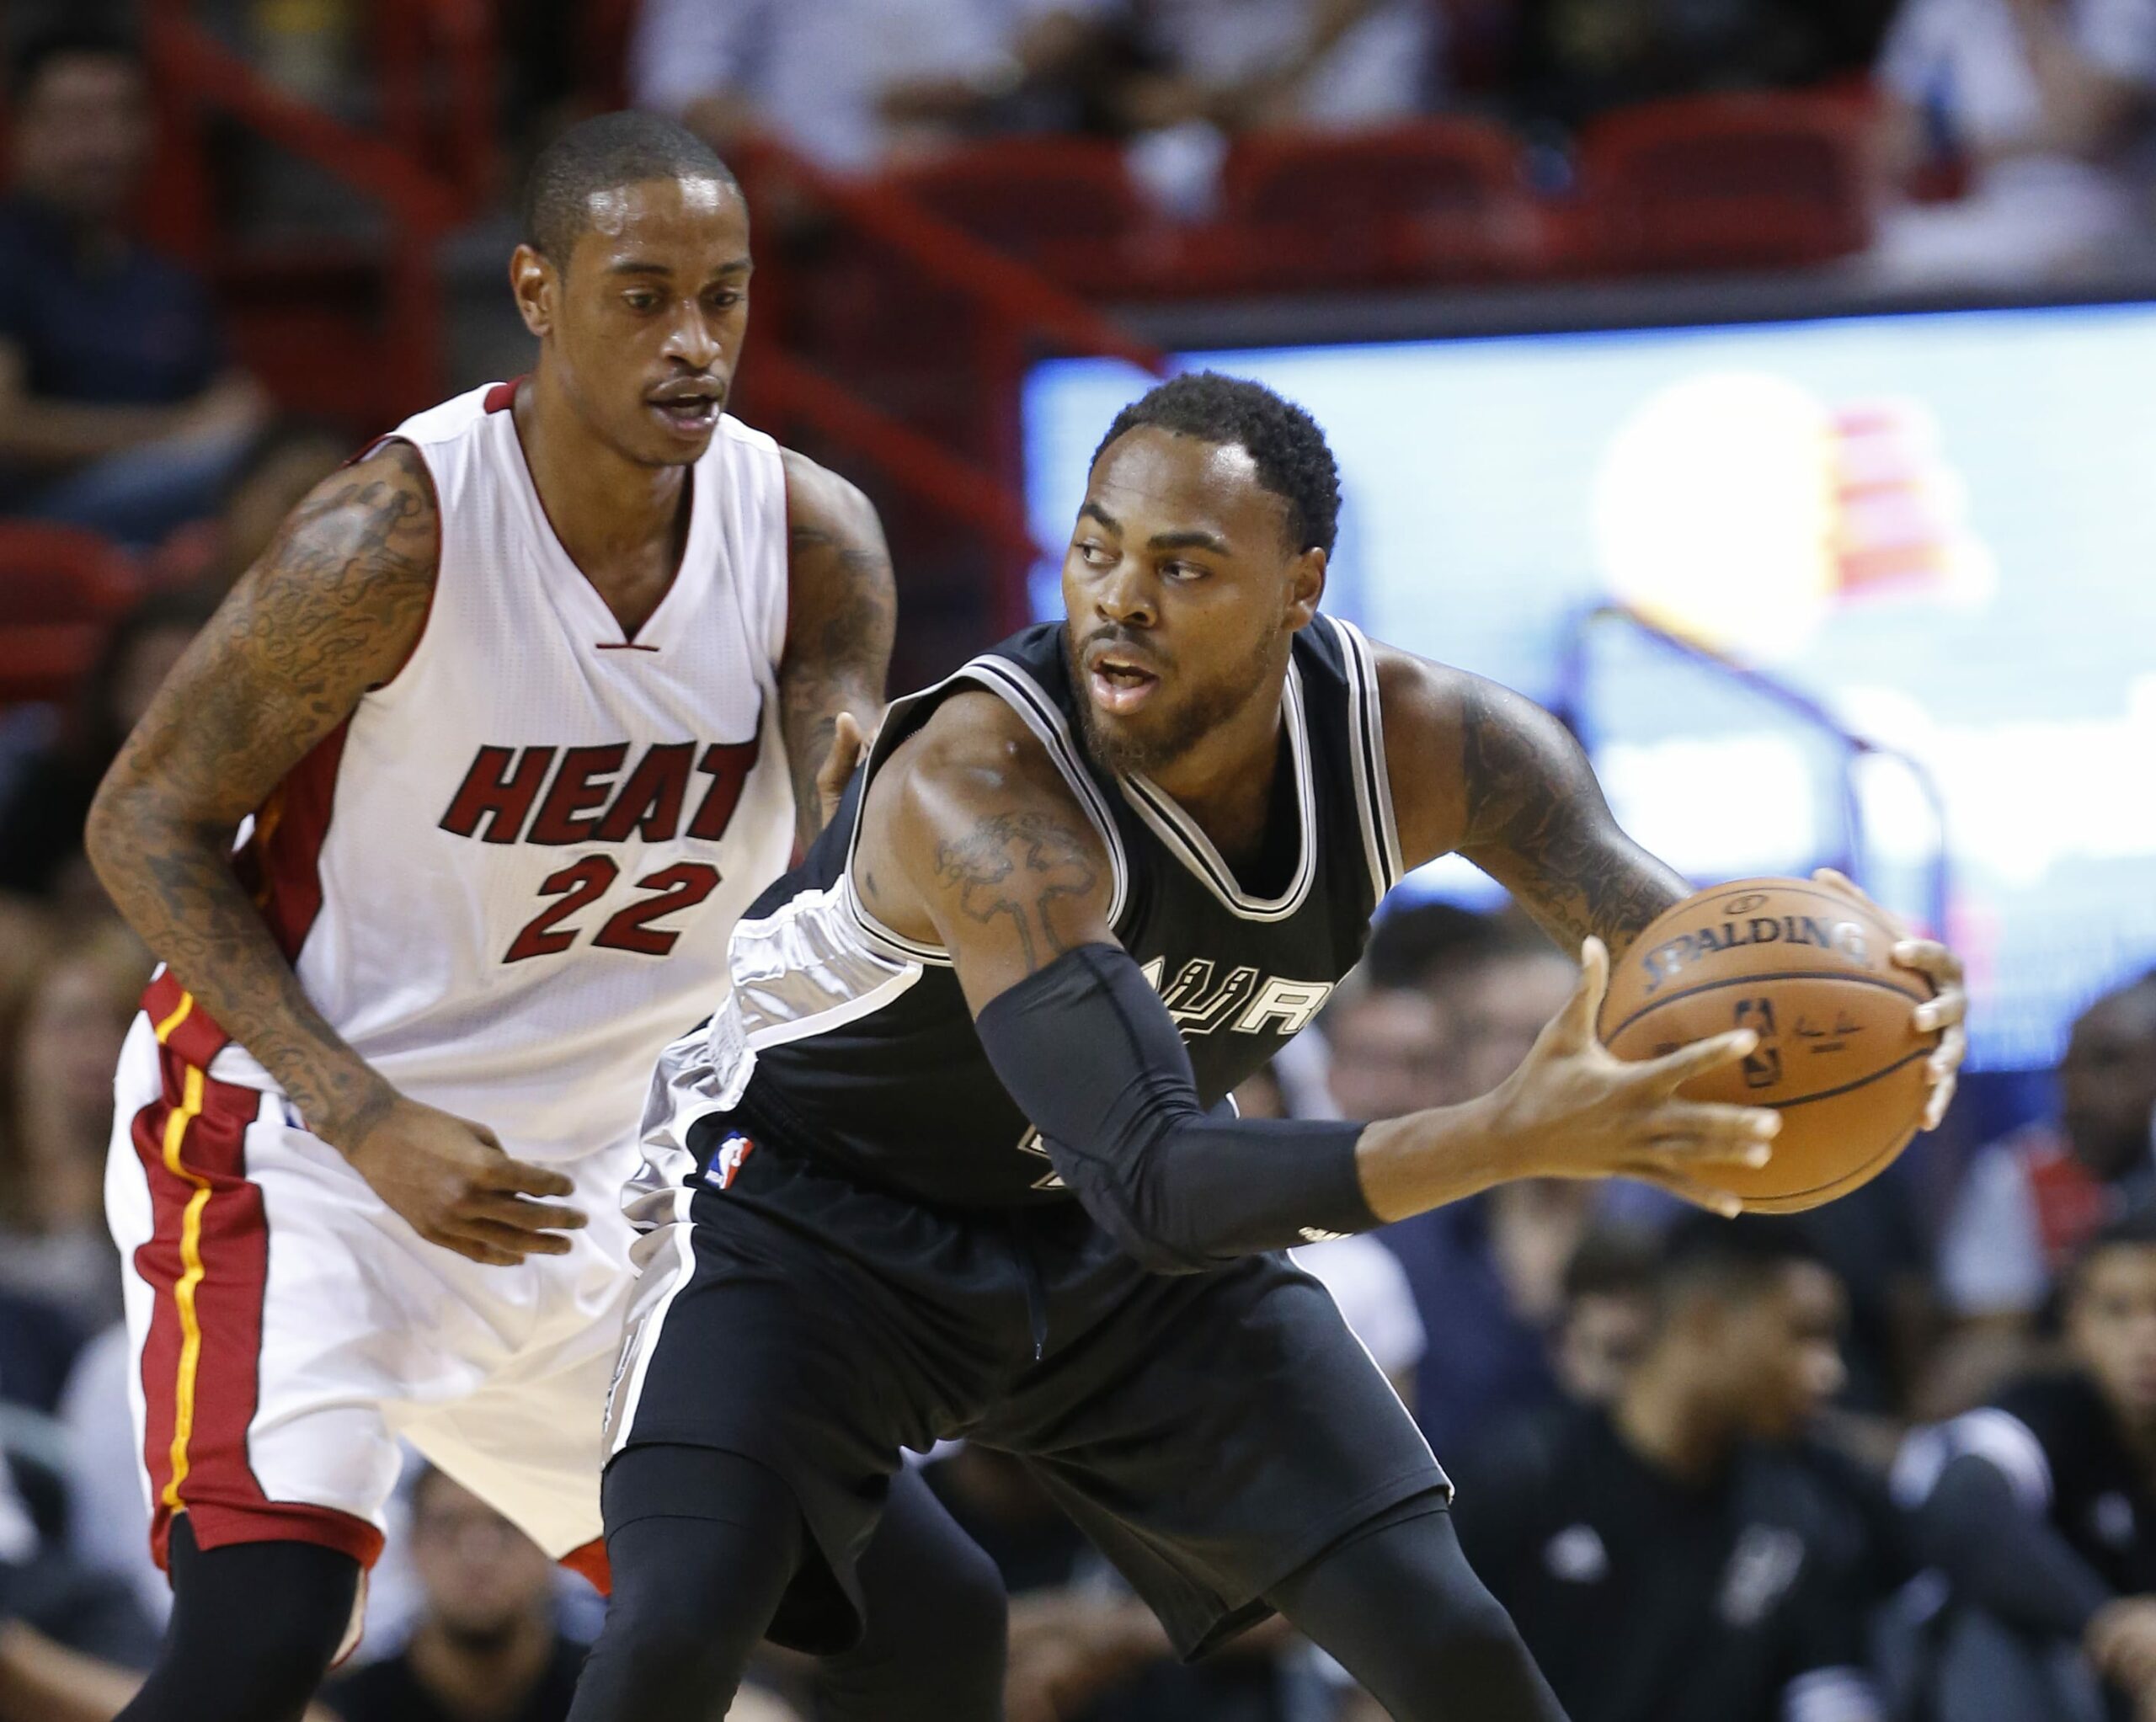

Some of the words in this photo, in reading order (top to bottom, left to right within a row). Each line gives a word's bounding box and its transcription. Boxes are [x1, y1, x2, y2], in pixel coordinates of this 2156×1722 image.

[438, 739, 760, 846] HEAT
[501, 853, 723, 964] 22
[1643, 914, 1872, 994] SPALDING
